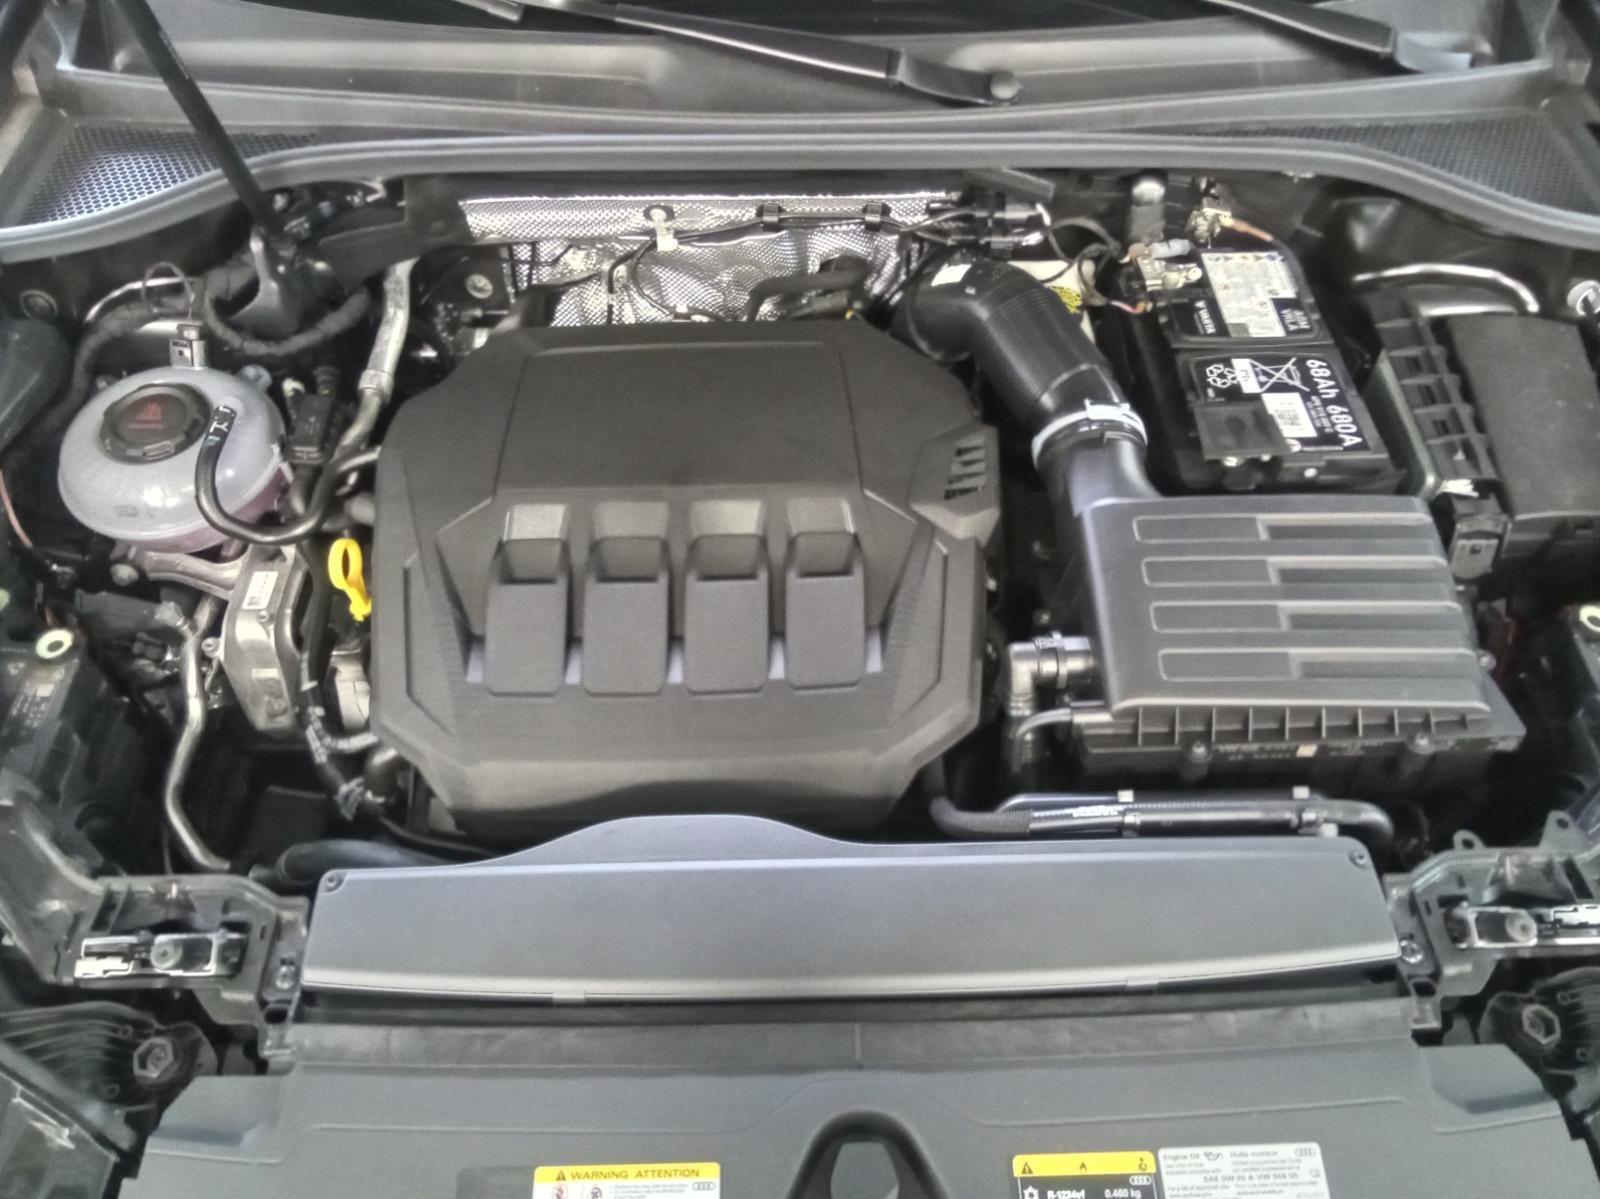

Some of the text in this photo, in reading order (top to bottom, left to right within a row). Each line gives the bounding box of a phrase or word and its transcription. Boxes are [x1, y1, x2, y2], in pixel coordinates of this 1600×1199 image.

[1199, 308, 1216, 334] VARTA
[1281, 309, 1299, 331] VRLA
[1306, 359, 1340, 398] 68Ah
[1326, 404, 1363, 447] 680A
[570, 1168, 700, 1180] WARNING ATTENTION
[1130, 1188, 1141, 1199] kg
